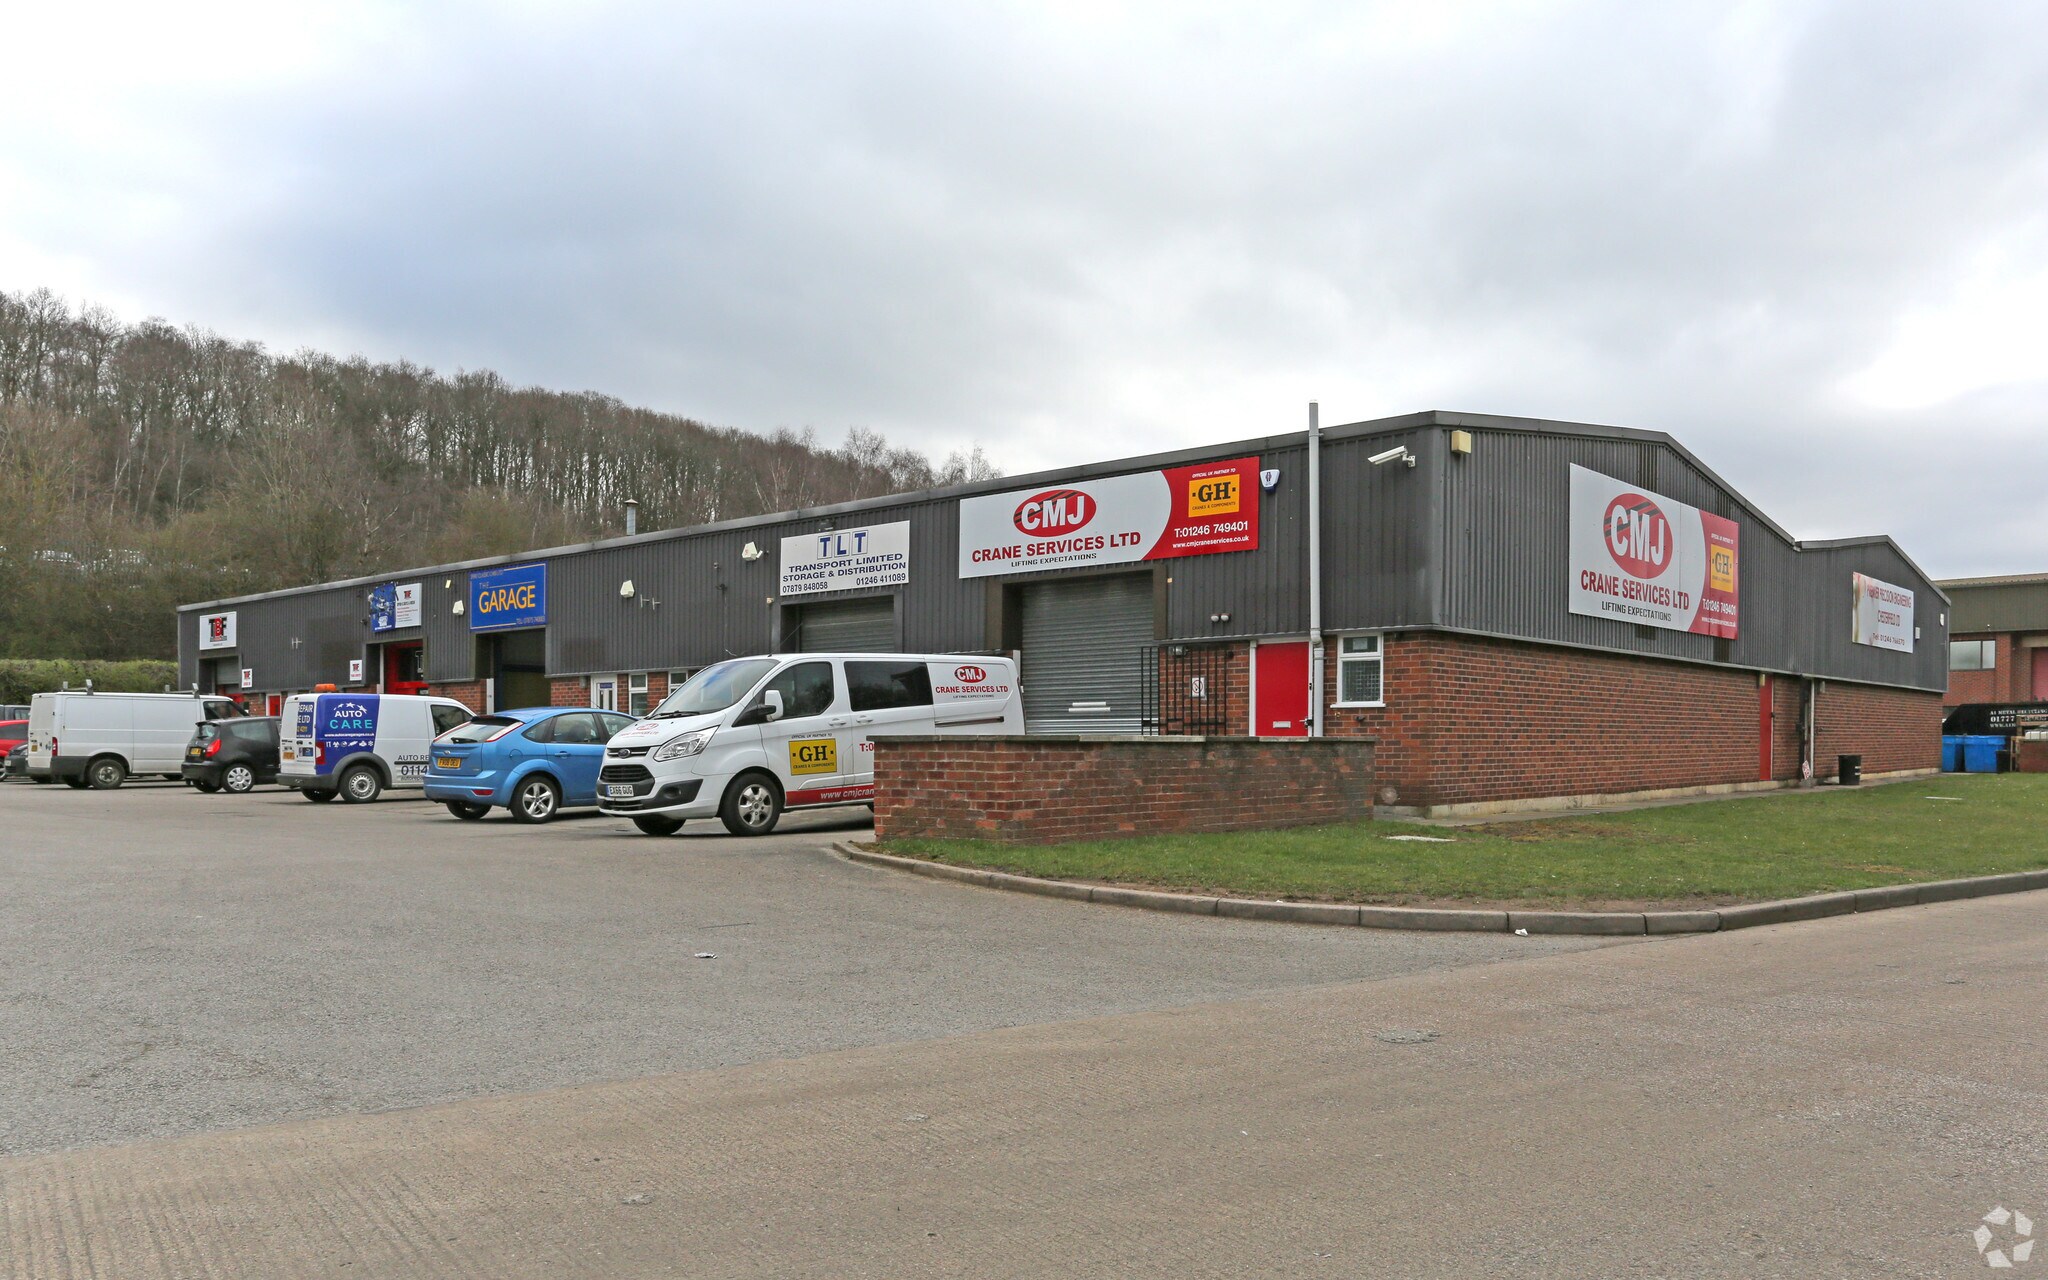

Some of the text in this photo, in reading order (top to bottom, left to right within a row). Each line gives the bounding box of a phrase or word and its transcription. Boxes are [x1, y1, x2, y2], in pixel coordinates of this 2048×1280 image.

[1198, 481, 1231, 502] GH
[1021, 496, 1085, 530] CMJ
[1174, 521, 1248, 538] T:01246 749401
[1610, 504, 1664, 566] CMJ
[820, 532, 866, 557] TLT
[972, 531, 1141, 562] CRANE SERVICES LTD
[1172, 535, 1249, 548] www.cmjcraneservices.co.uk
[789, 553, 902, 573] TRANSPORT LIMITED
[1011, 552, 1097, 568] LIFTING EXPECTATIONS
[1715, 552, 1730, 575] GH
[783, 572, 825, 582] STORAGE
[838, 562, 906, 576] DISTRIBUTION
[479, 581, 489, 589] THE
[783, 573, 906, 593] 07879 848058 01246 411089
[1580, 569, 1689, 610] CRANE SERVICES LTD
[479, 585, 536, 613] GARAGE
[1601, 601, 1672, 622] LIFTING EXPECTATIONS
[957, 668, 983, 680] CMJ
[935, 686, 960, 694] CRANE
[330, 720, 373, 729] CARE
[799, 745, 828, 762] GH
